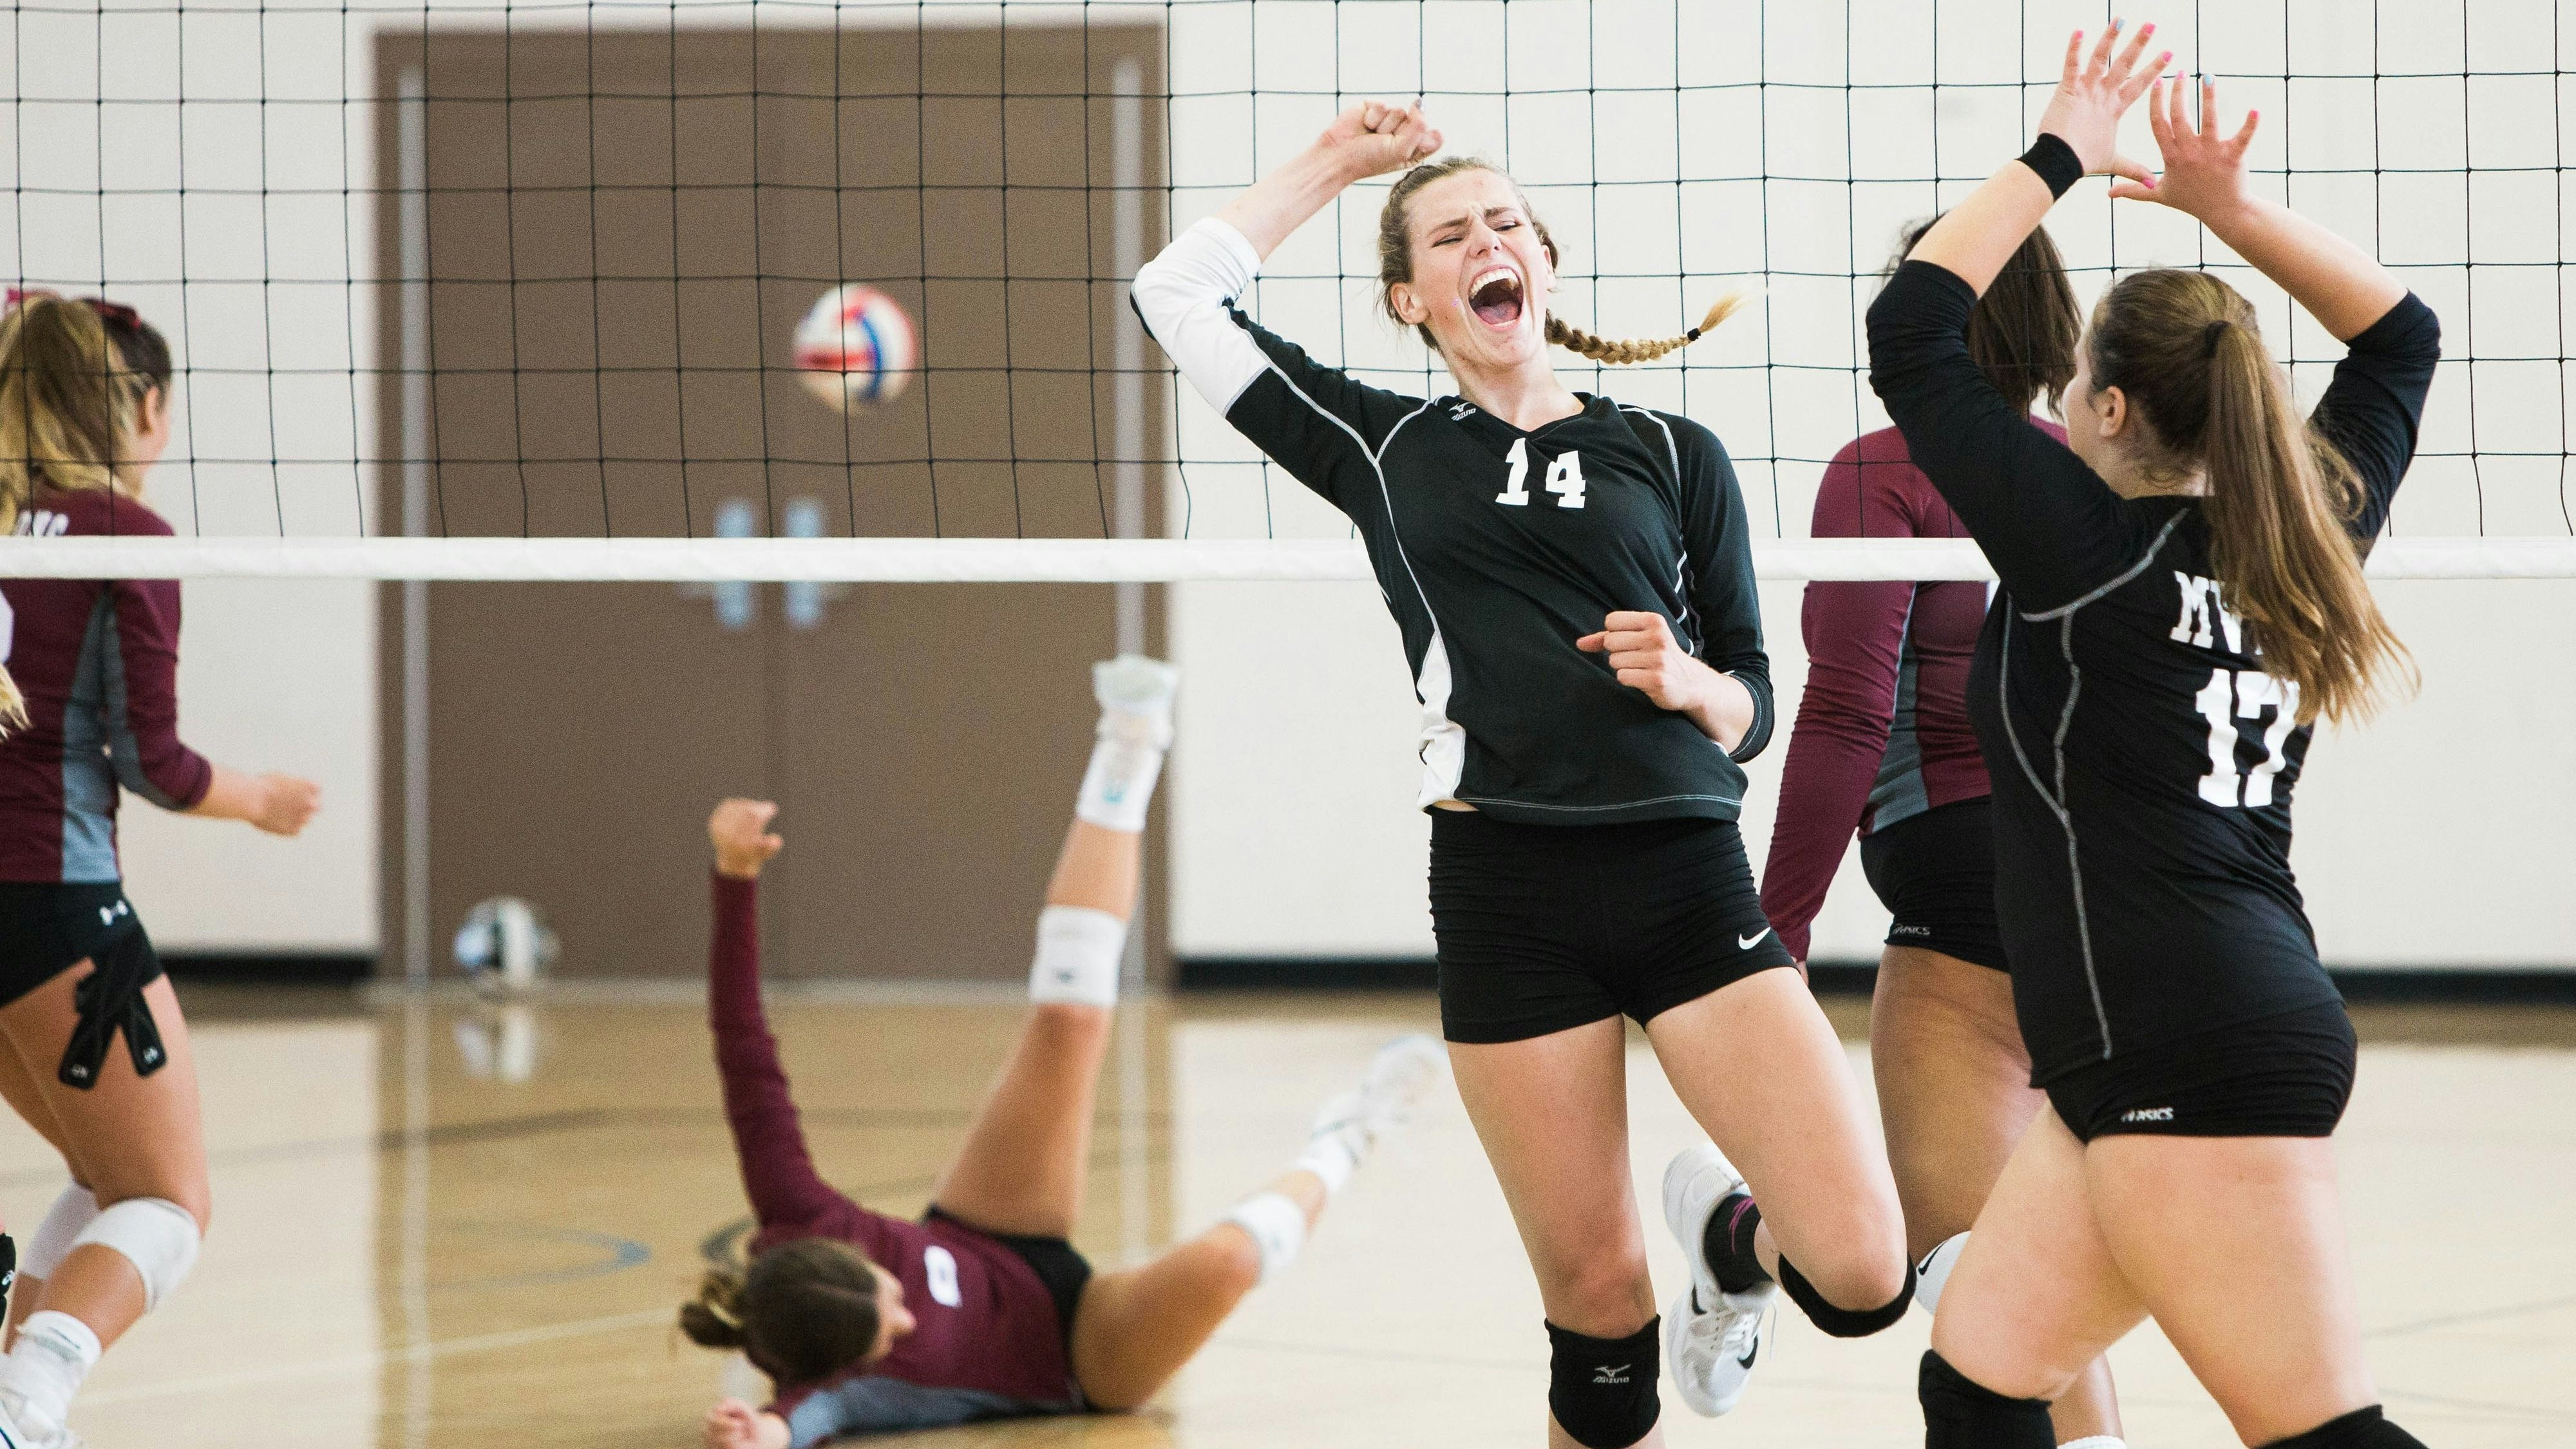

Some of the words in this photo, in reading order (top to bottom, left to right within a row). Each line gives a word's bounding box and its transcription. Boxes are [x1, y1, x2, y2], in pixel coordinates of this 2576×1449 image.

[1495, 438, 1586, 508] 14
[2170, 570, 2264, 656] MV
[2195, 668, 2300, 808] 17
